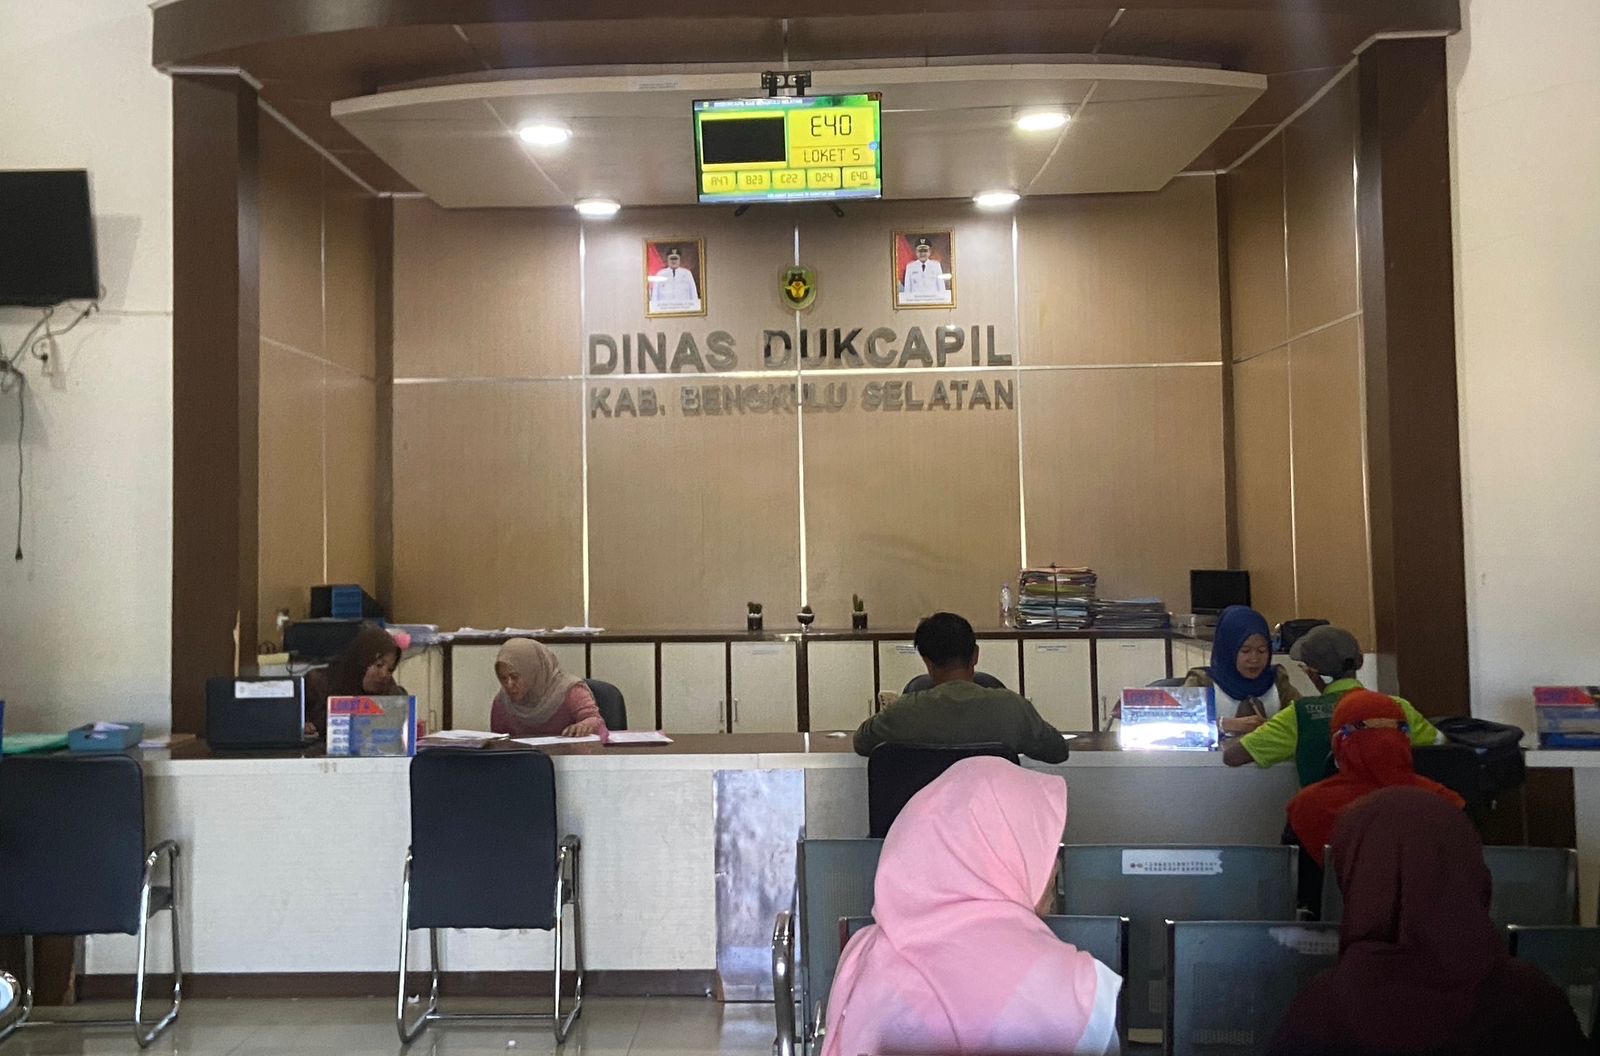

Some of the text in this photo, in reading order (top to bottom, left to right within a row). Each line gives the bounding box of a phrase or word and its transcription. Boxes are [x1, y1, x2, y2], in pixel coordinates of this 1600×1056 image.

[811, 114, 851, 137] E40
[803, 148, 846, 163] LOKET
[745, 174, 764, 186] B23
[780, 173, 798, 184] C22
[815, 172, 834, 183] D24
[850, 170, 868, 182] E40
[588, 324, 1013, 375] DINAS DUKCAPIL
[590, 379, 1014, 419] KAB. BENGKULU SELATAN
